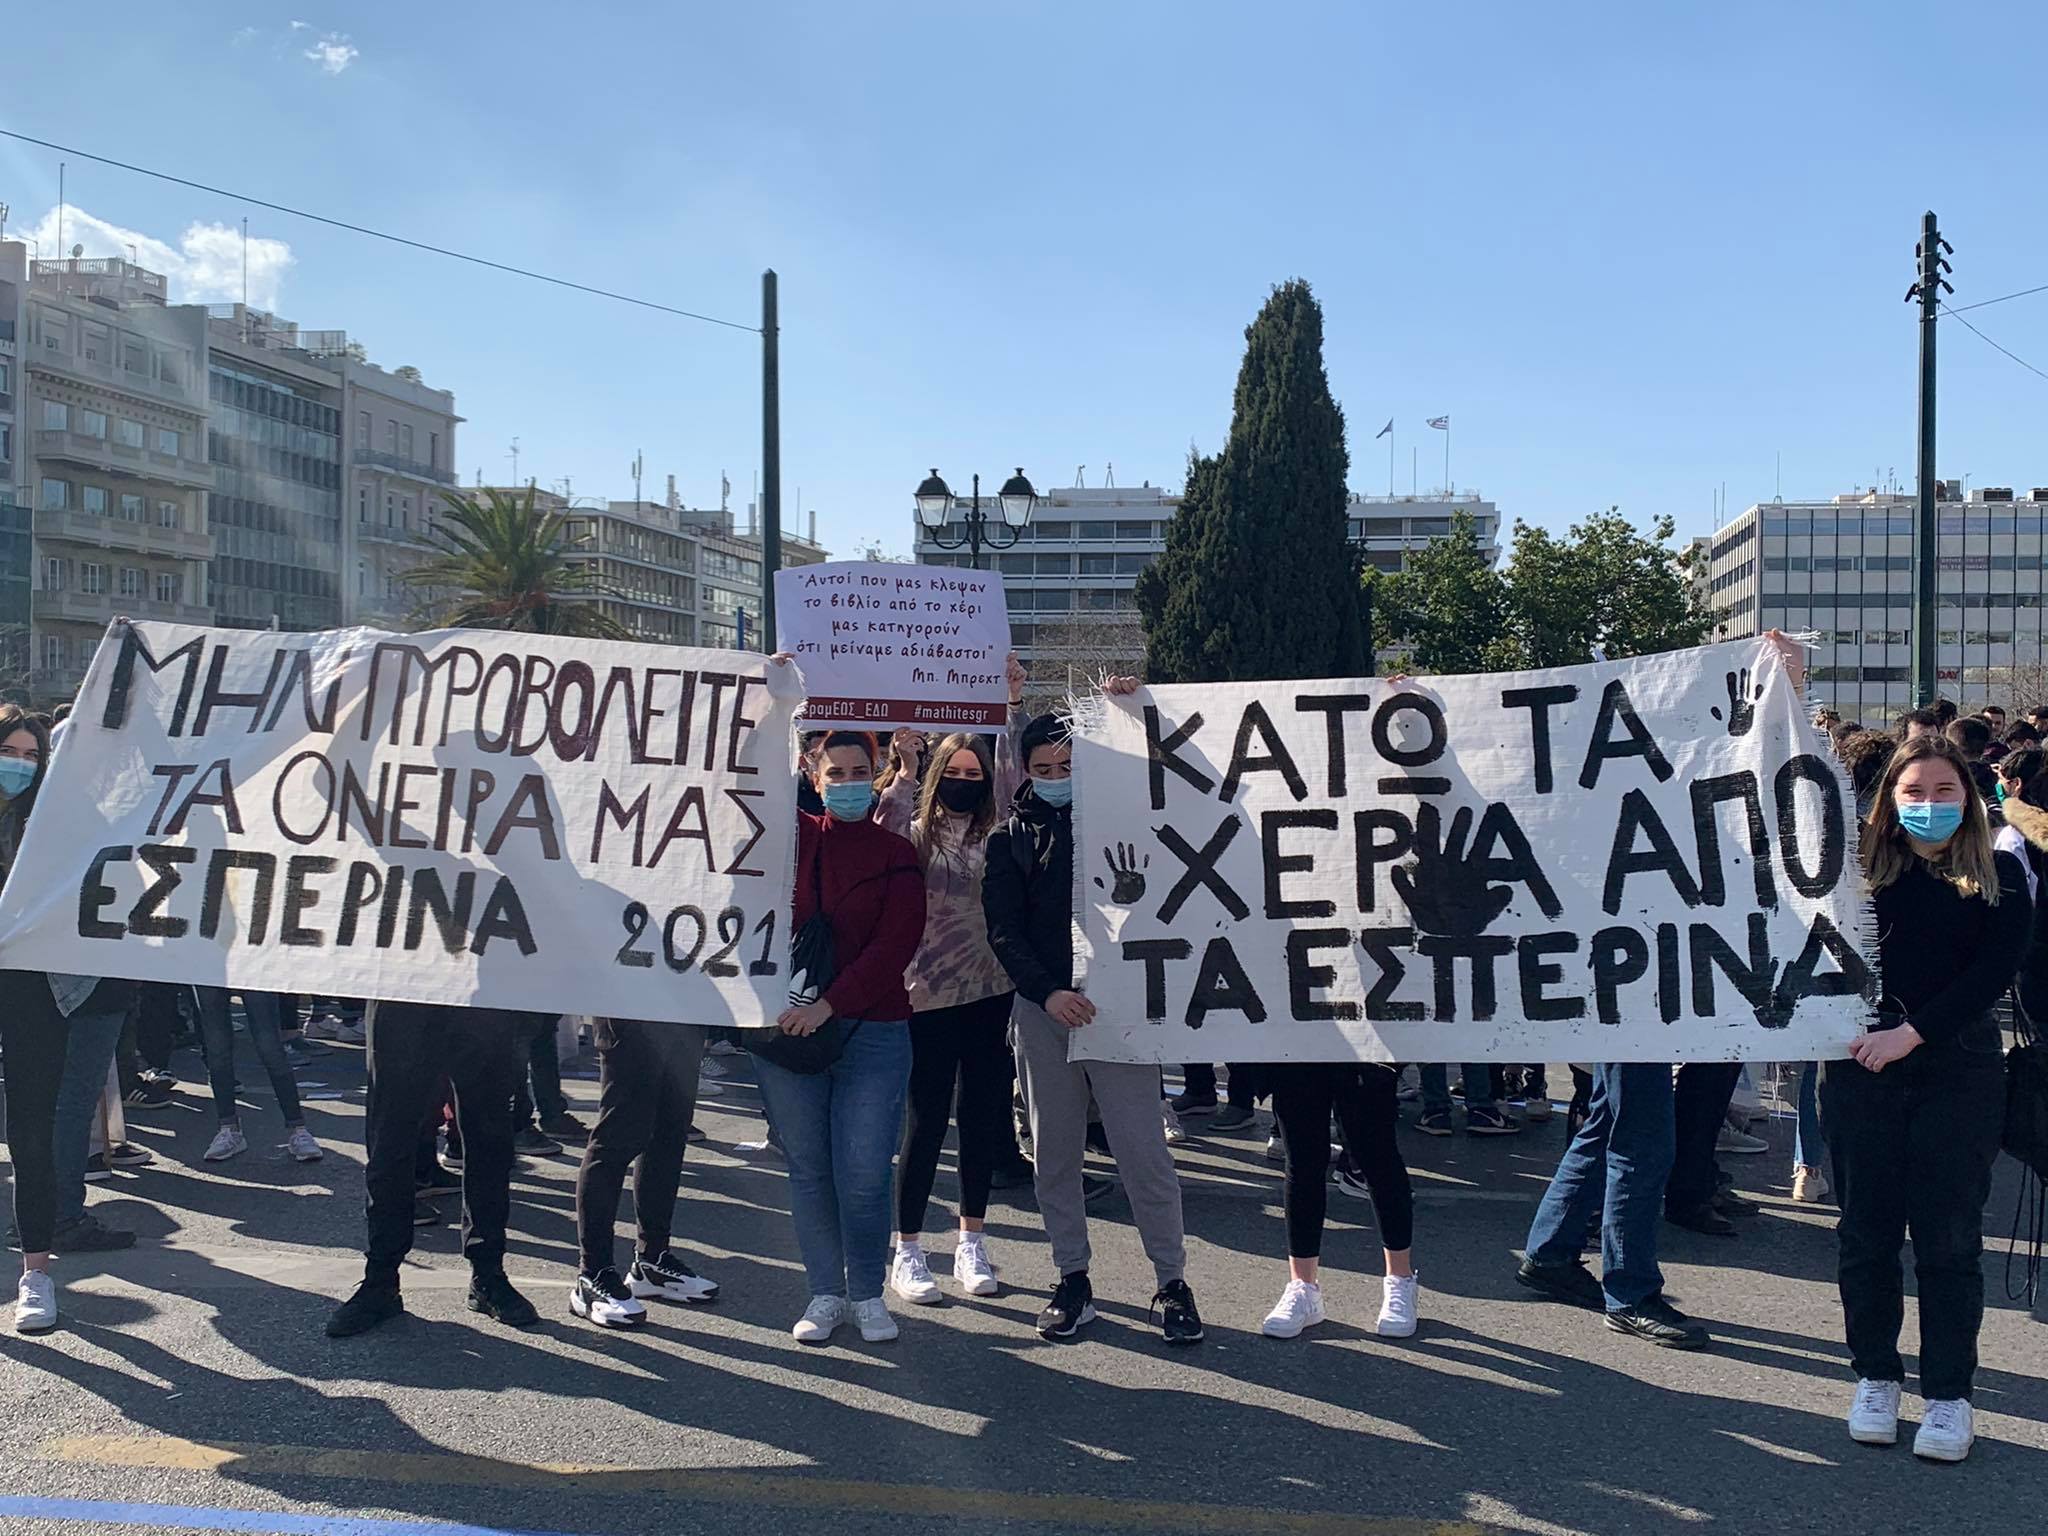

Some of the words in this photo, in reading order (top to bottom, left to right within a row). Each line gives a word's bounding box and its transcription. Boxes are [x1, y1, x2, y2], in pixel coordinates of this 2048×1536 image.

[804, 598, 821, 608] το
[831, 593, 881, 609] βιβλίο
[889, 599, 917, 611] από
[924, 601, 941, 612] το
[949, 601, 982, 619] χέρι
[860, 575, 887, 587] που
[895, 578, 922, 593] μας
[930, 577, 986, 597] κλεψαν
[796, 640, 821, 653] ότι
[830, 641, 893, 662] μείναμε
[832, 620, 859, 636] μας
[868, 621, 961, 639] κατηγορούν
[102, 624, 351, 738] ΜΗΝ
[360, 642, 768, 775] ΠΥΡΟΒΟΛΕΙΤΕ
[914, 704, 988, 724] #mathitesgr
[946, 668, 1001, 688] Μπρεχτ
[1142, 692, 1453, 811] ΚΑΤΩ
[1501, 679, 1675, 794] ΤΑ
[146, 758, 246, 836] ΤΑ
[273, 751, 561, 861] ΟΝΕΙΡΑ
[589, 779, 767, 878] ΜΑΣ
[1601, 753, 1846, 916] ΑΠΟ
[78, 843, 537, 957] ΕΣΠΕΡΙΝΑ
[614, 902, 779, 977] 2021
[1122, 936, 1268, 1029] ΤΑ
[1287, 913, 1877, 1029] ΕΣΠΕΡΙΝΑ
